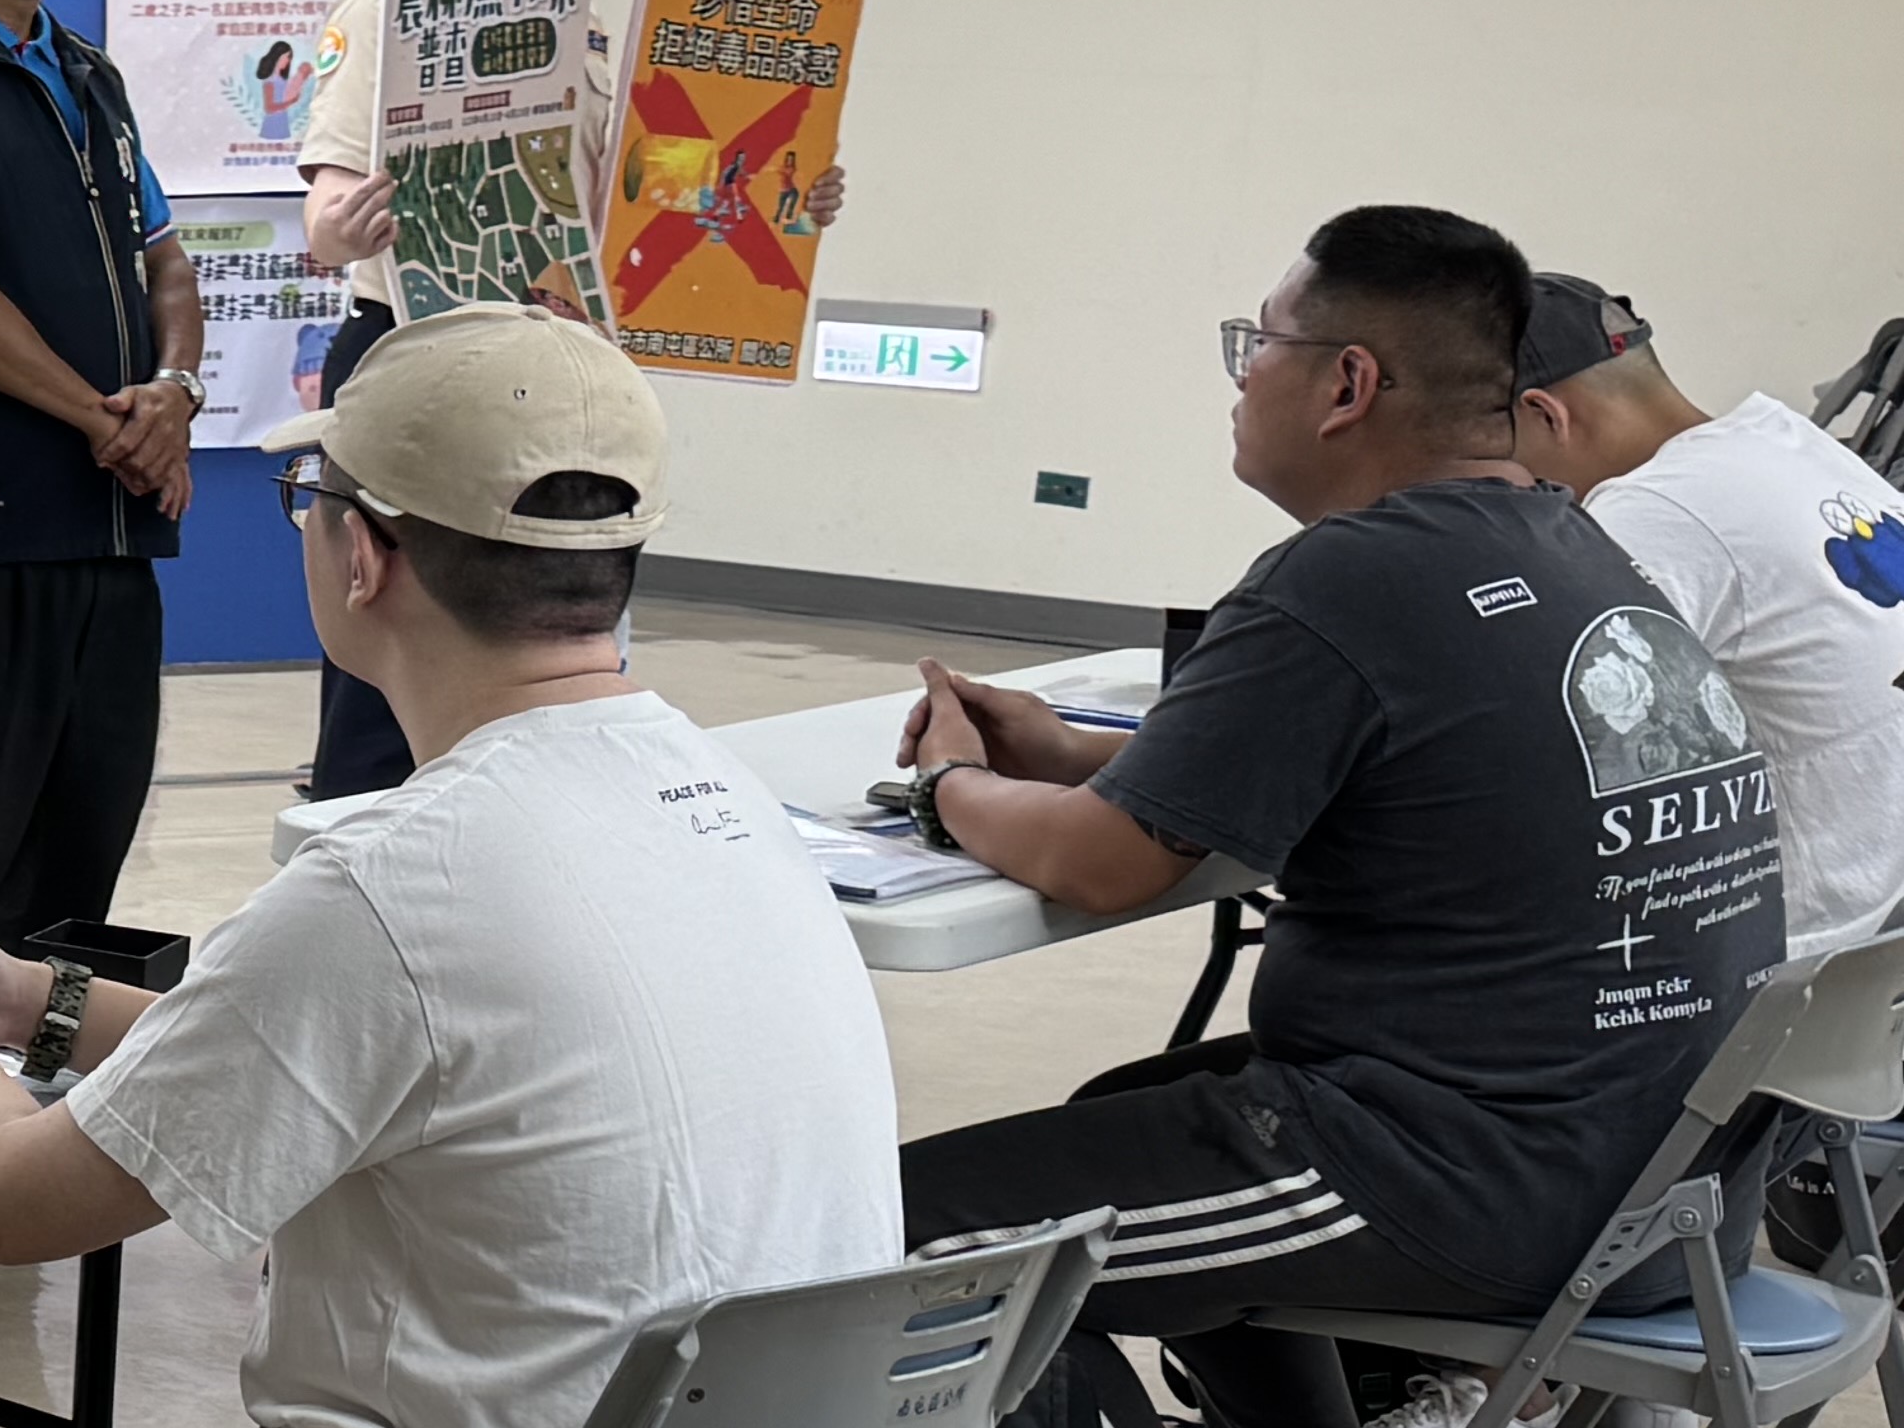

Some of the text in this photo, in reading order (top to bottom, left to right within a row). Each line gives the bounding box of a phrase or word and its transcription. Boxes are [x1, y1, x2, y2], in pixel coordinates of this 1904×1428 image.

[417, 22, 468, 88] 普查
[649, 18, 840, 89] 拒絕毒品誘惑
